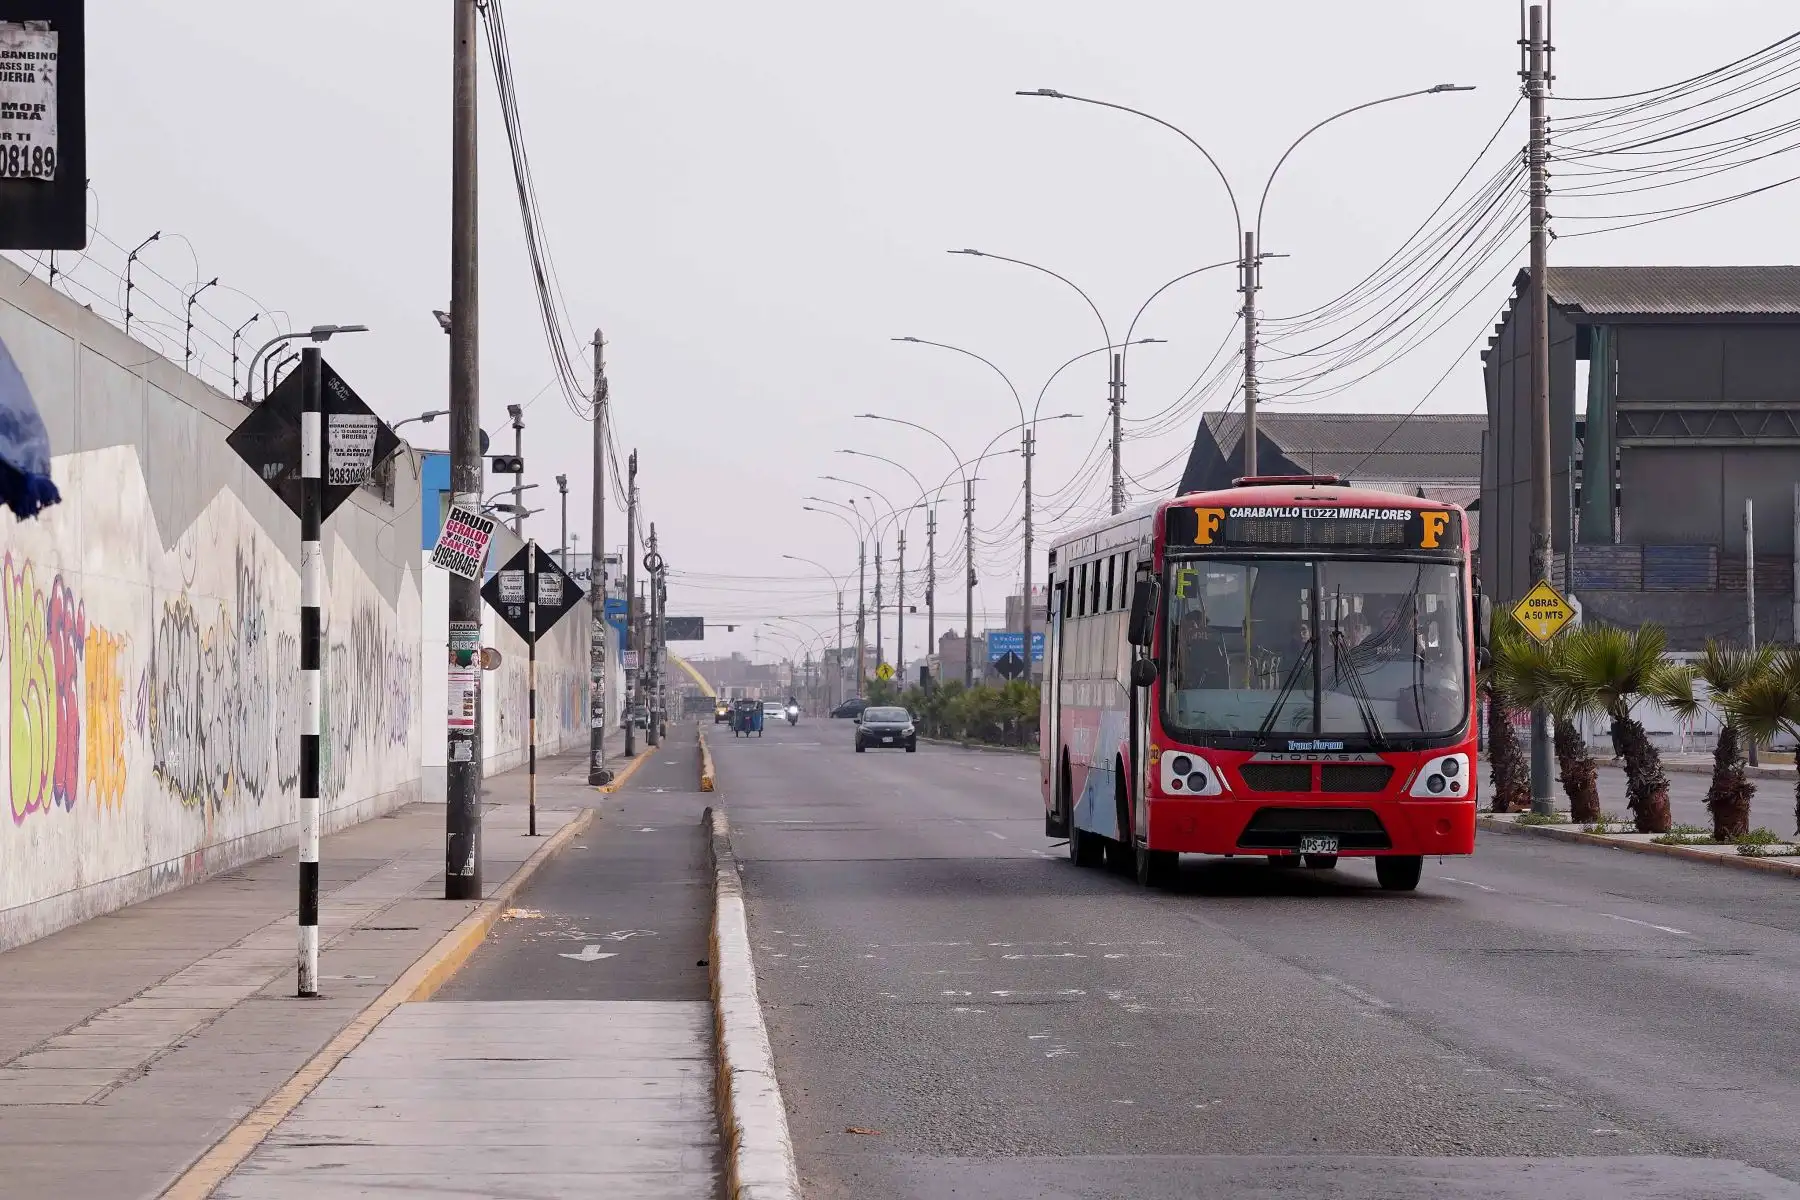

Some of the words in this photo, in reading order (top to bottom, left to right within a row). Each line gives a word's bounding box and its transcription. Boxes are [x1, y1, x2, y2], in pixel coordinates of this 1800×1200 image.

[0, 51, 57, 60] BANBINO
[24, 63, 36, 71] DE
[16, 133, 31, 141] TI
[1229, 507, 1300, 518] CARABAYLLO
[1303, 508, 1337, 518] 1022
[1339, 508, 1412, 520] MIRAFLORES
[450, 507, 494, 534] BRUJO
[1194, 508, 1225, 544] F
[446, 519, 489, 545] GERALDO
[1420, 512, 1449, 548] F
[440, 536, 482, 559] SANTOS
[453, 534, 462, 543] DE
[462, 537, 475, 548] LOS
[1175, 568, 1200, 599] F
[1529, 599, 1558, 607] OBRAS
[1533, 611, 1542, 619] 50
[1545, 611, 1563, 619] MTS
[1301, 840, 1337, 851] APS-912
